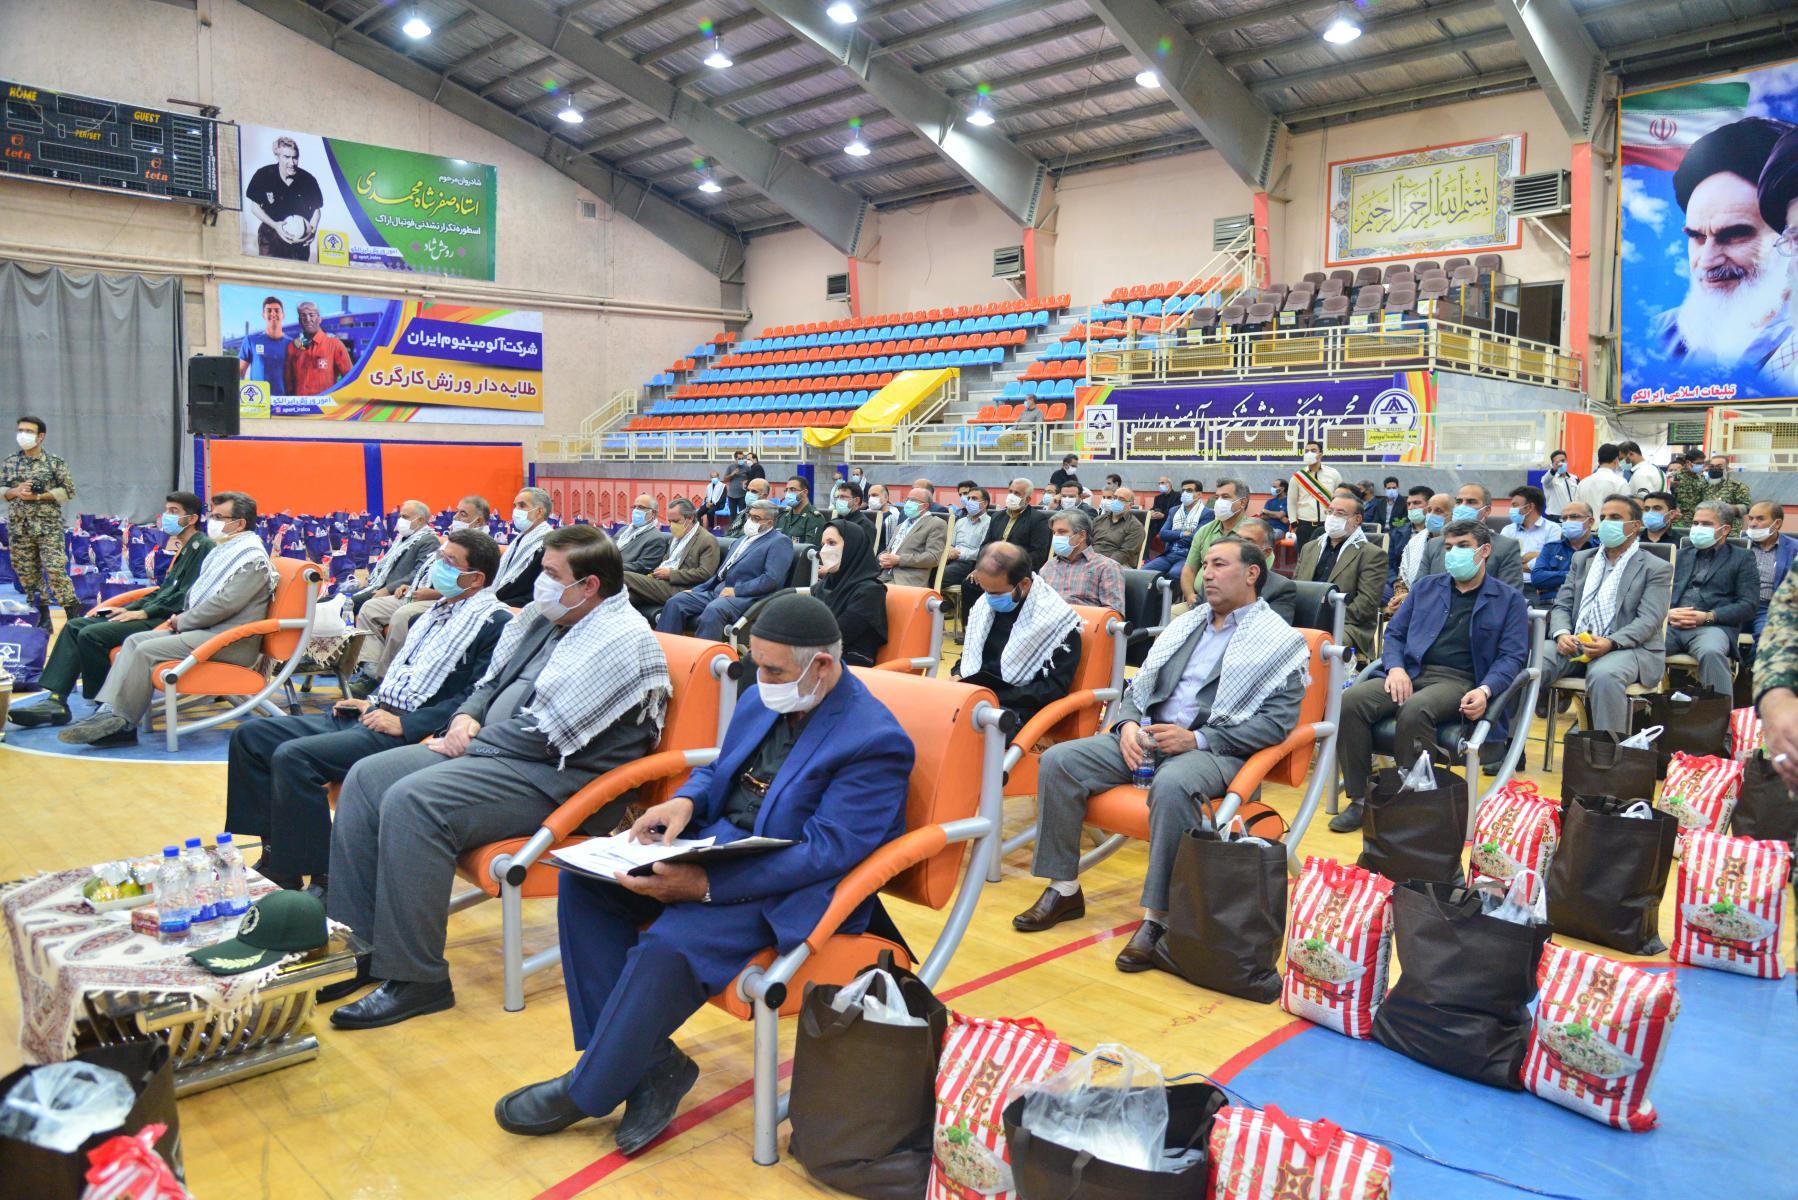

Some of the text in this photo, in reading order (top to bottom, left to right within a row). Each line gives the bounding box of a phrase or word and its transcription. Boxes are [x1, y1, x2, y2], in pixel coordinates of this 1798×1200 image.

[9, 86, 38, 101] HOME
[133, 111, 160, 123] GUEST
[52, 170, 58, 178] 2
[457, 175, 482, 187] شادروان
[374, 214, 481, 235] اسطوره تکرار نشدنی فوتبال اراک
[407, 330, 538, 357] شرکت آلومینیوم ایران
[369, 366, 537, 398] طلایه دار ورزش کارگری
[1631, 384, 1737, 404] تبلیغات اسلامی ایرالکو
[1679, 780, 1702, 793] GTC
[1491, 821, 1514, 836] GTC
[1715, 877, 1748, 892] GTC
[1315, 912, 1342, 929] GTC
[1577, 993, 1614, 1015] GTC
[961, 1088, 991, 1113] GTC
